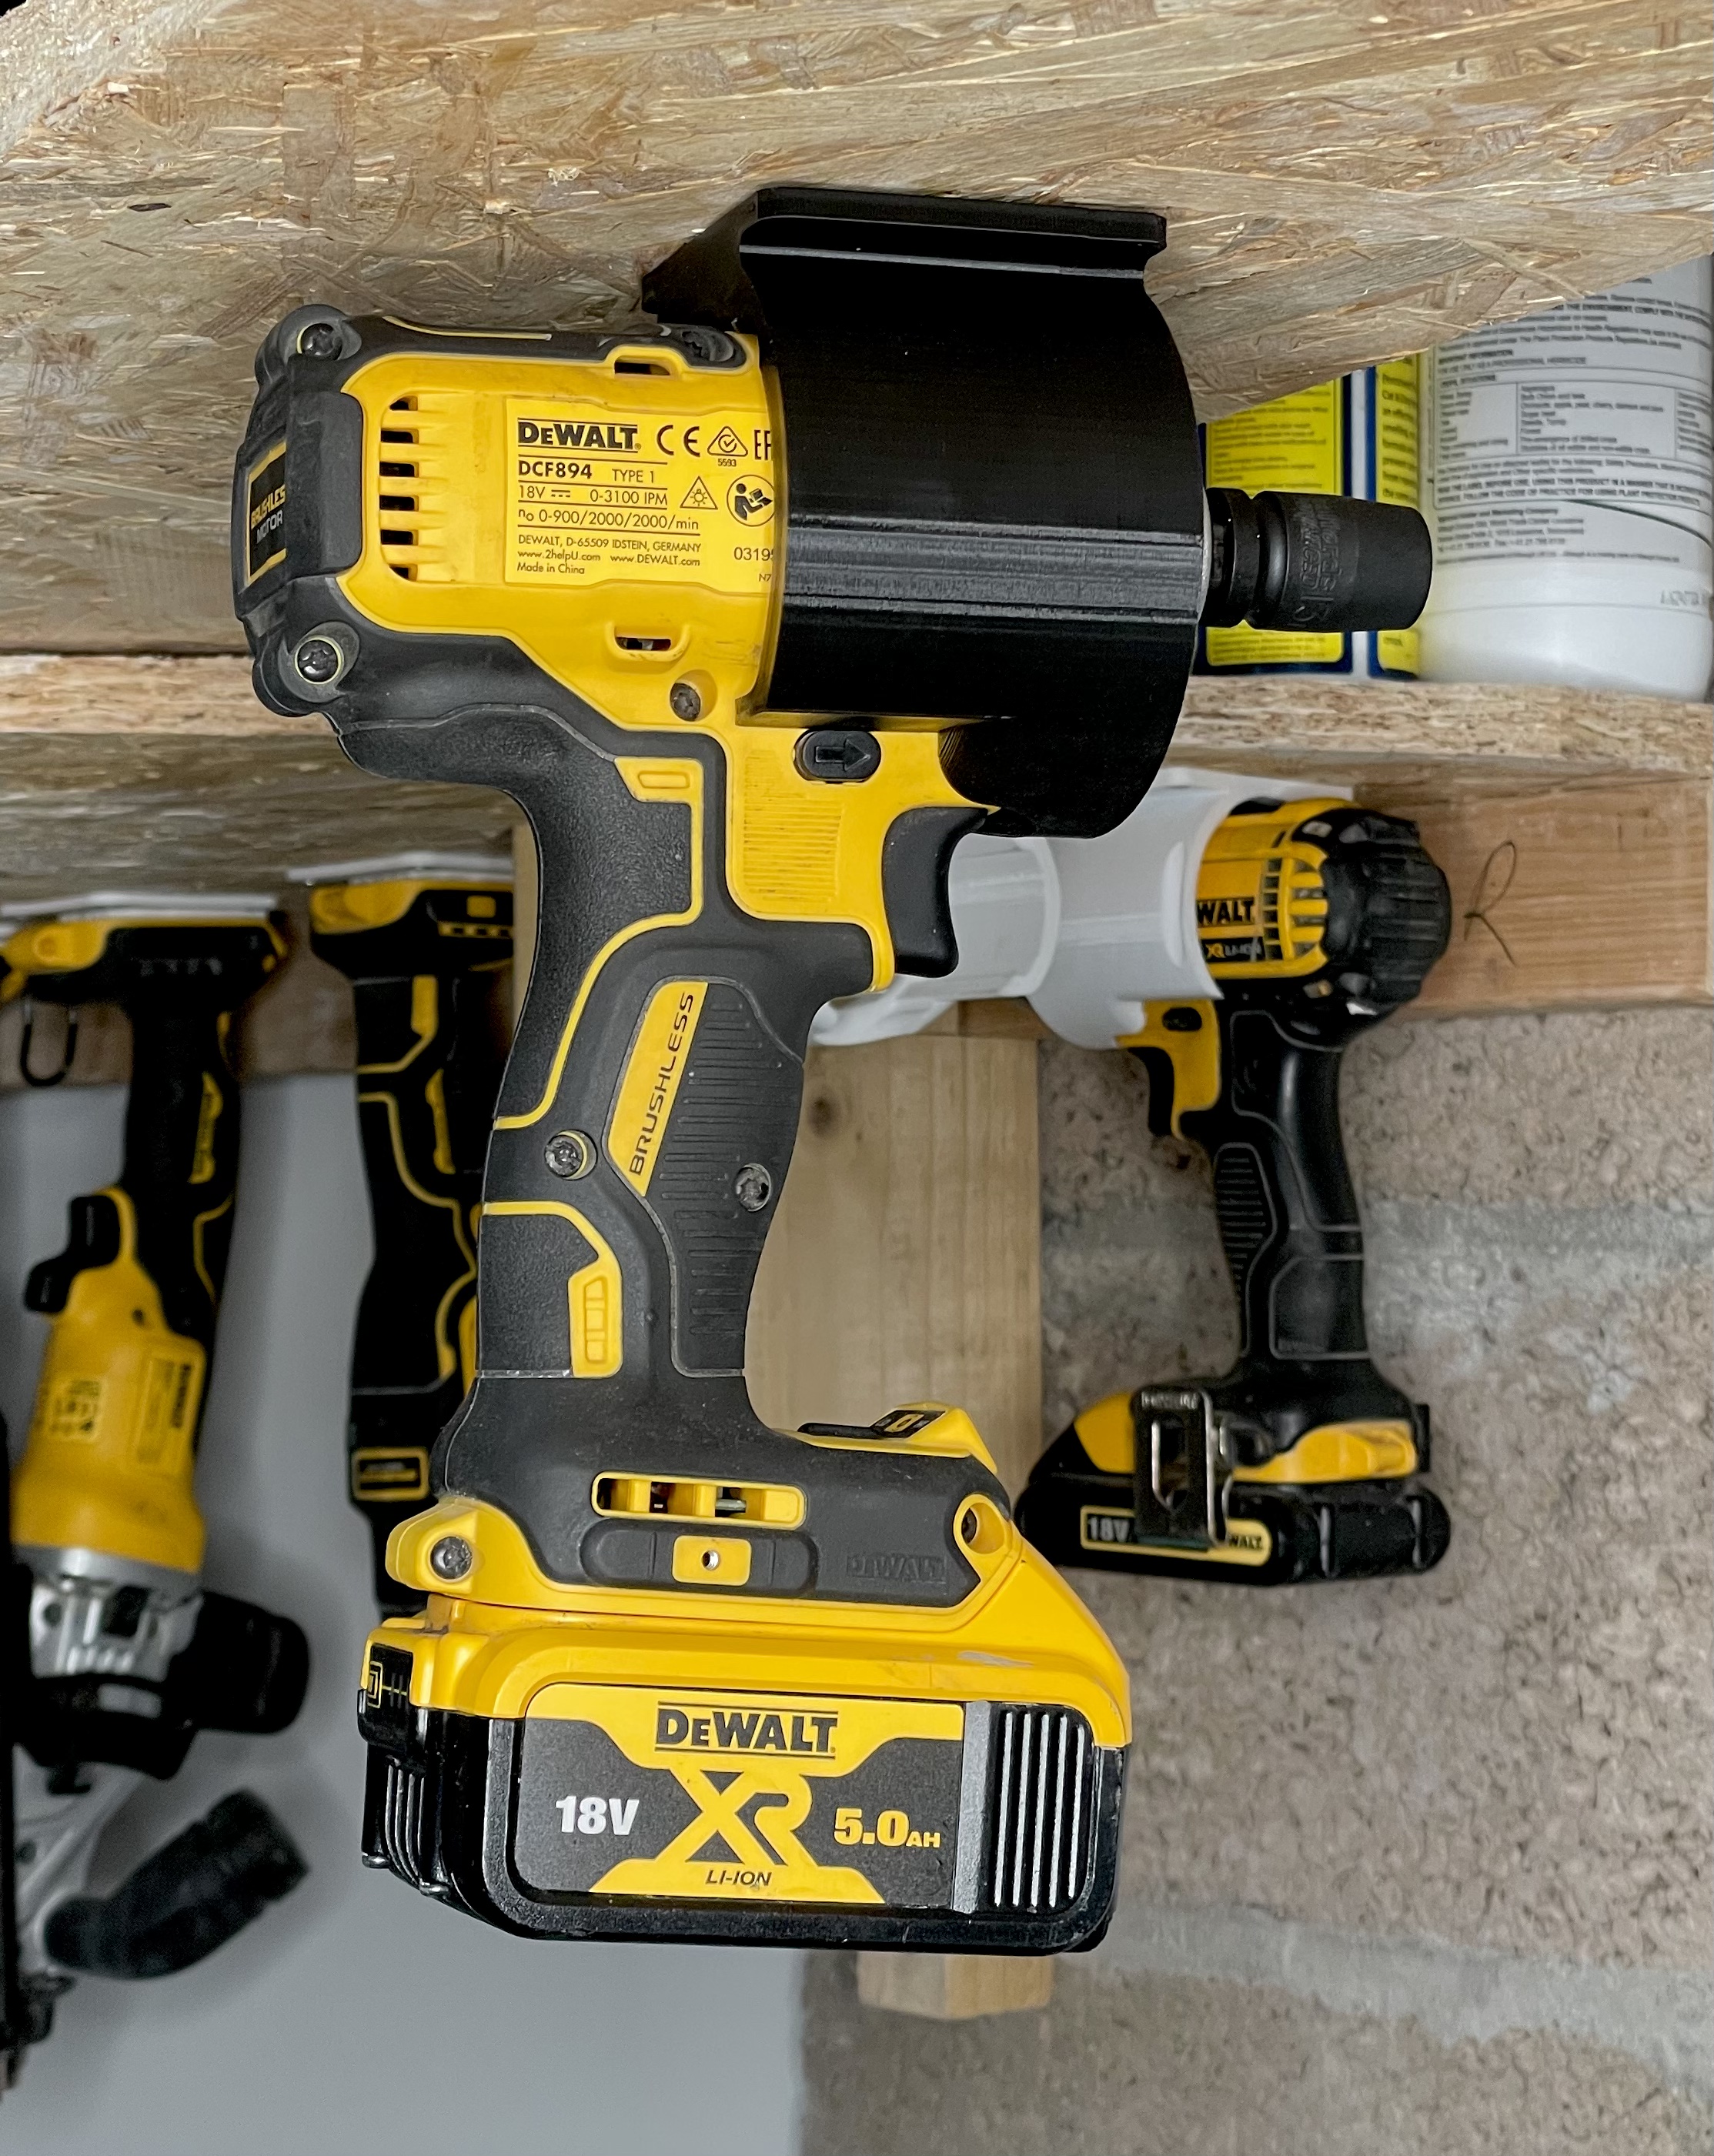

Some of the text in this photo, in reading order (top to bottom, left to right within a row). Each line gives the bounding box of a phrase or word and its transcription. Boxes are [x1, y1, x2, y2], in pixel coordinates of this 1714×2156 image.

[519, 461, 592, 479] DCF894
[612, 469, 655, 482] TYPE 1
[519, 486, 667, 506] 18V 0-3100 IPM
[566, 537, 609, 547] D-65509
[653, 541, 701, 552] GERMANY
[517, 562, 585, 575] Made in China
[1198, 899, 1253, 924] WALT
[629, 992, 693, 1176] BRUSHLESS
[555, 1795, 640, 1836] 18V
[706, 1869, 772, 1887] LI-ION
